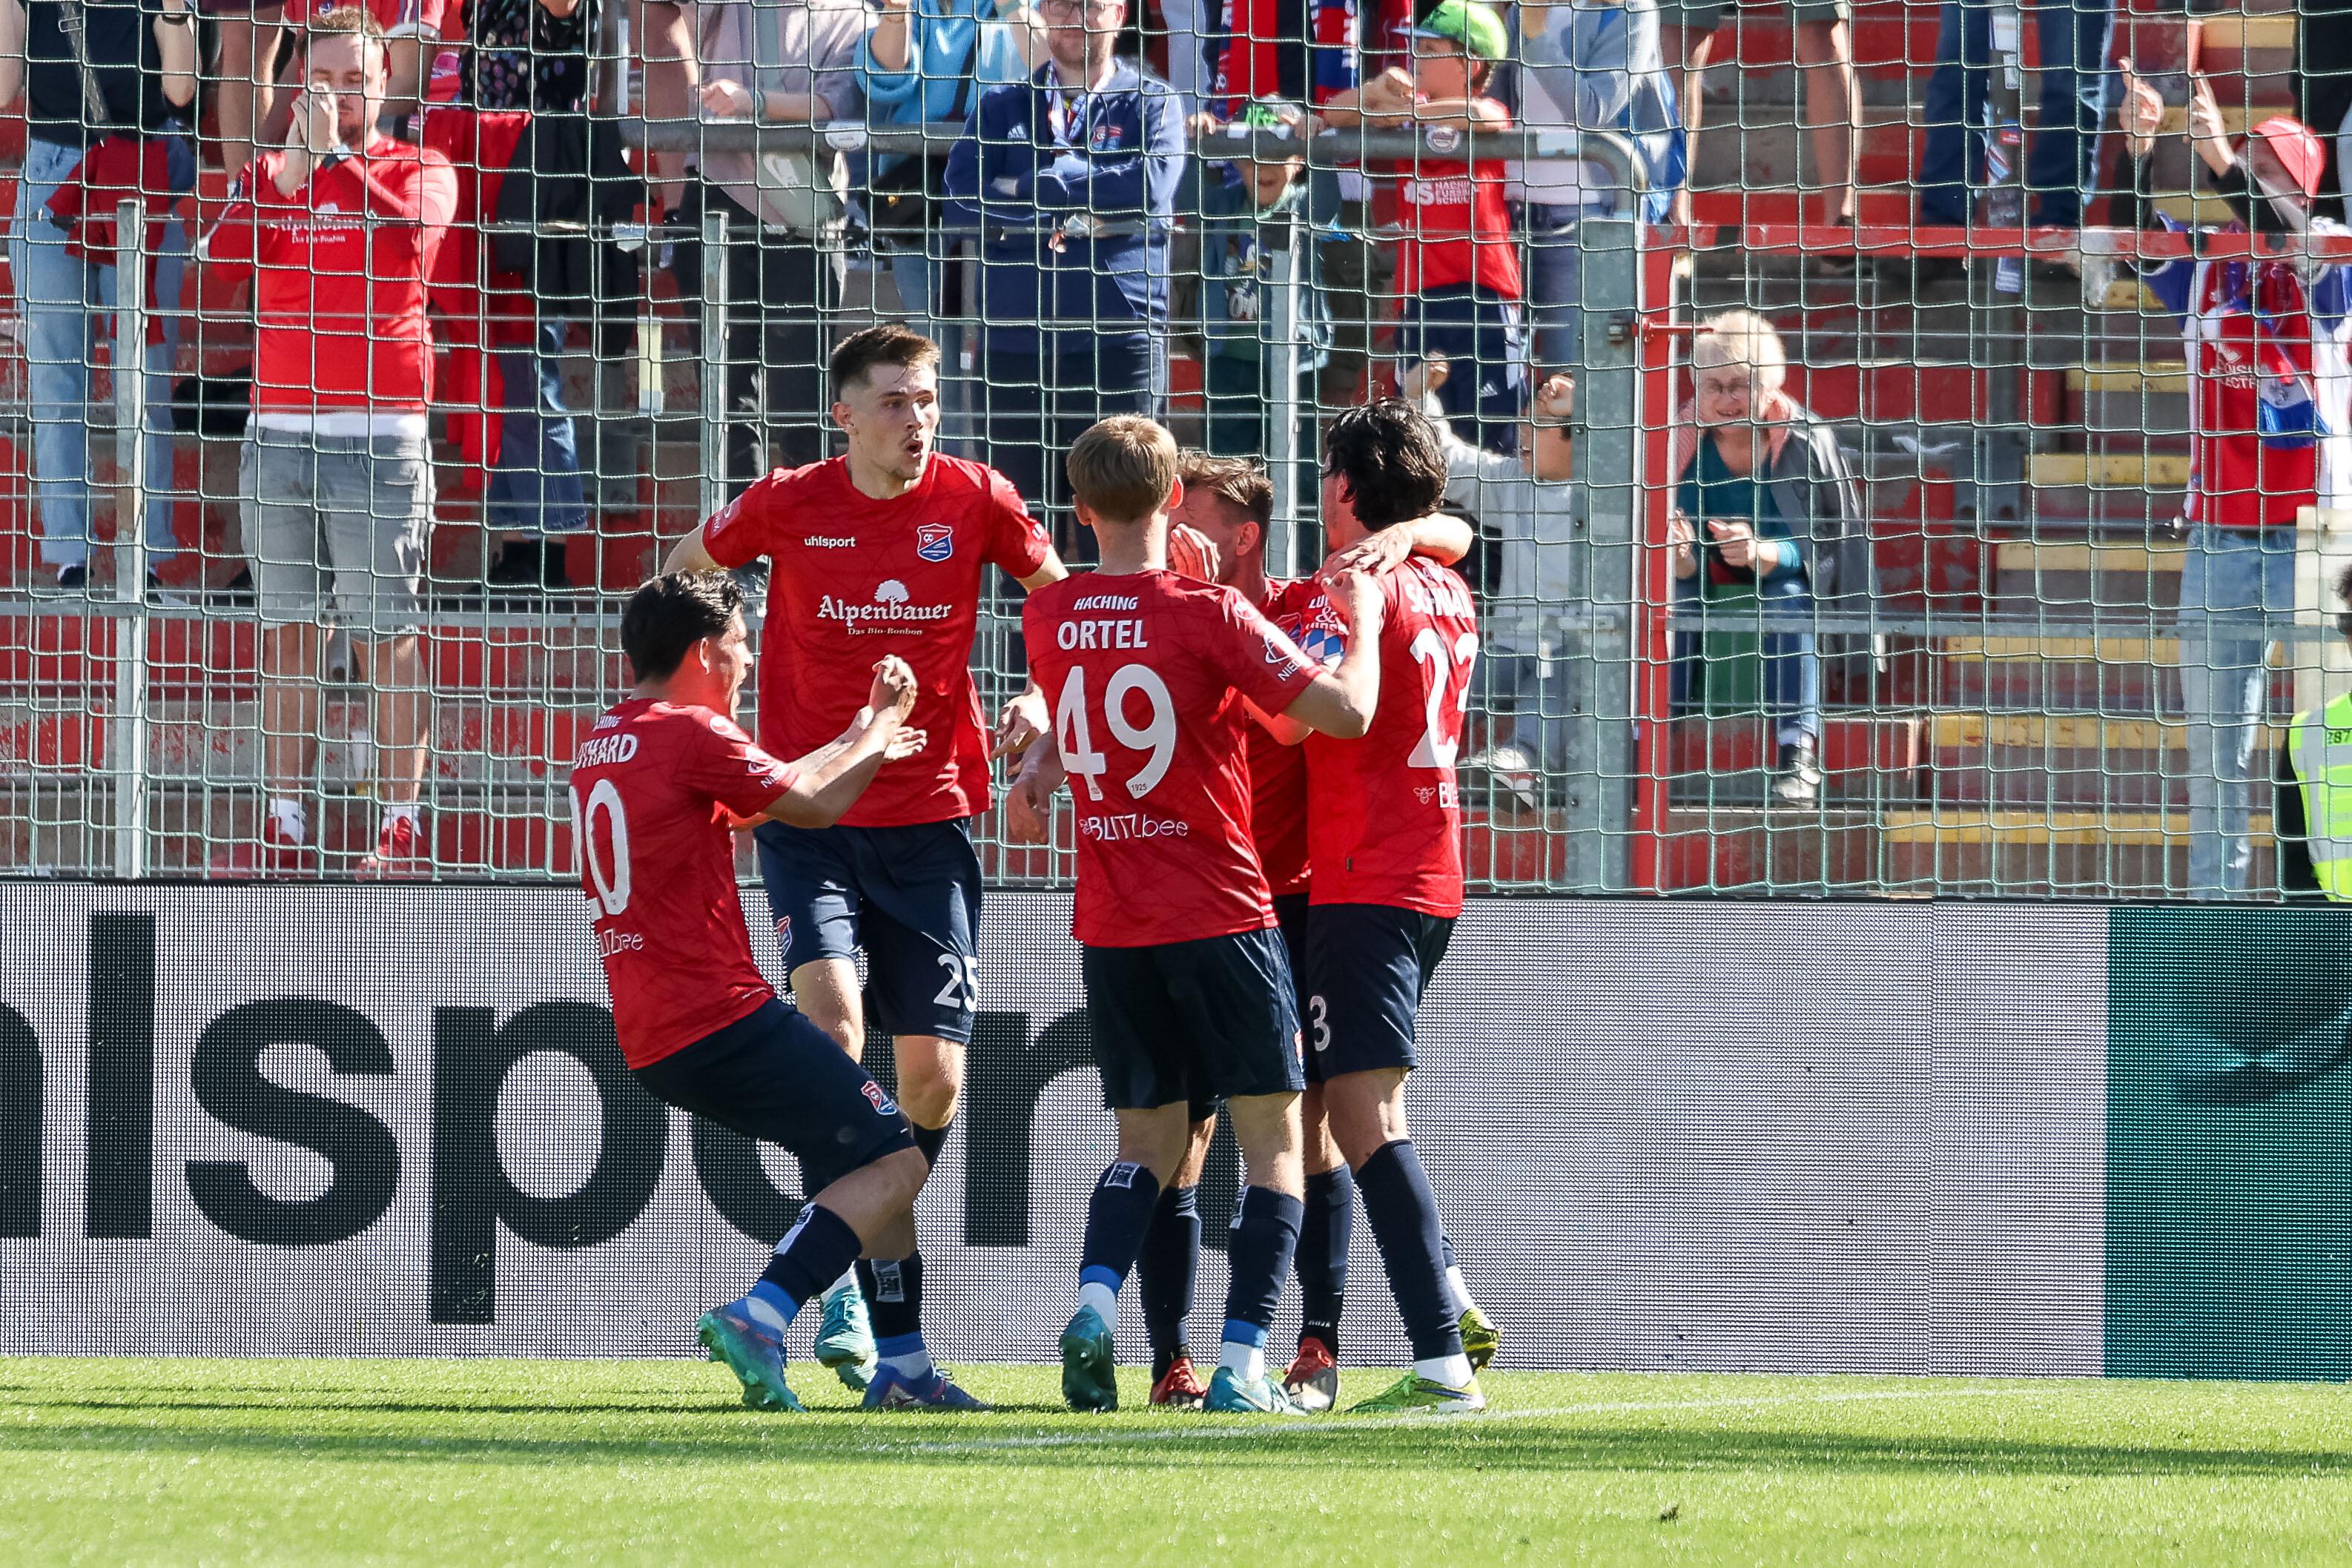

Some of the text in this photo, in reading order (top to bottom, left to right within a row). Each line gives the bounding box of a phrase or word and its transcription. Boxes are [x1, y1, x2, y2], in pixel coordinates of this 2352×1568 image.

[805, 535, 856, 549] uhlsport
[817, 595, 952, 627] Alpenbauer
[1074, 595, 1138, 611] HACHING
[1057, 620, 1149, 650] ORTEL
[1056, 664, 1177, 801] 49
[1132, 783, 1148, 792] 1925
[934, 953, 978, 1013] 25
